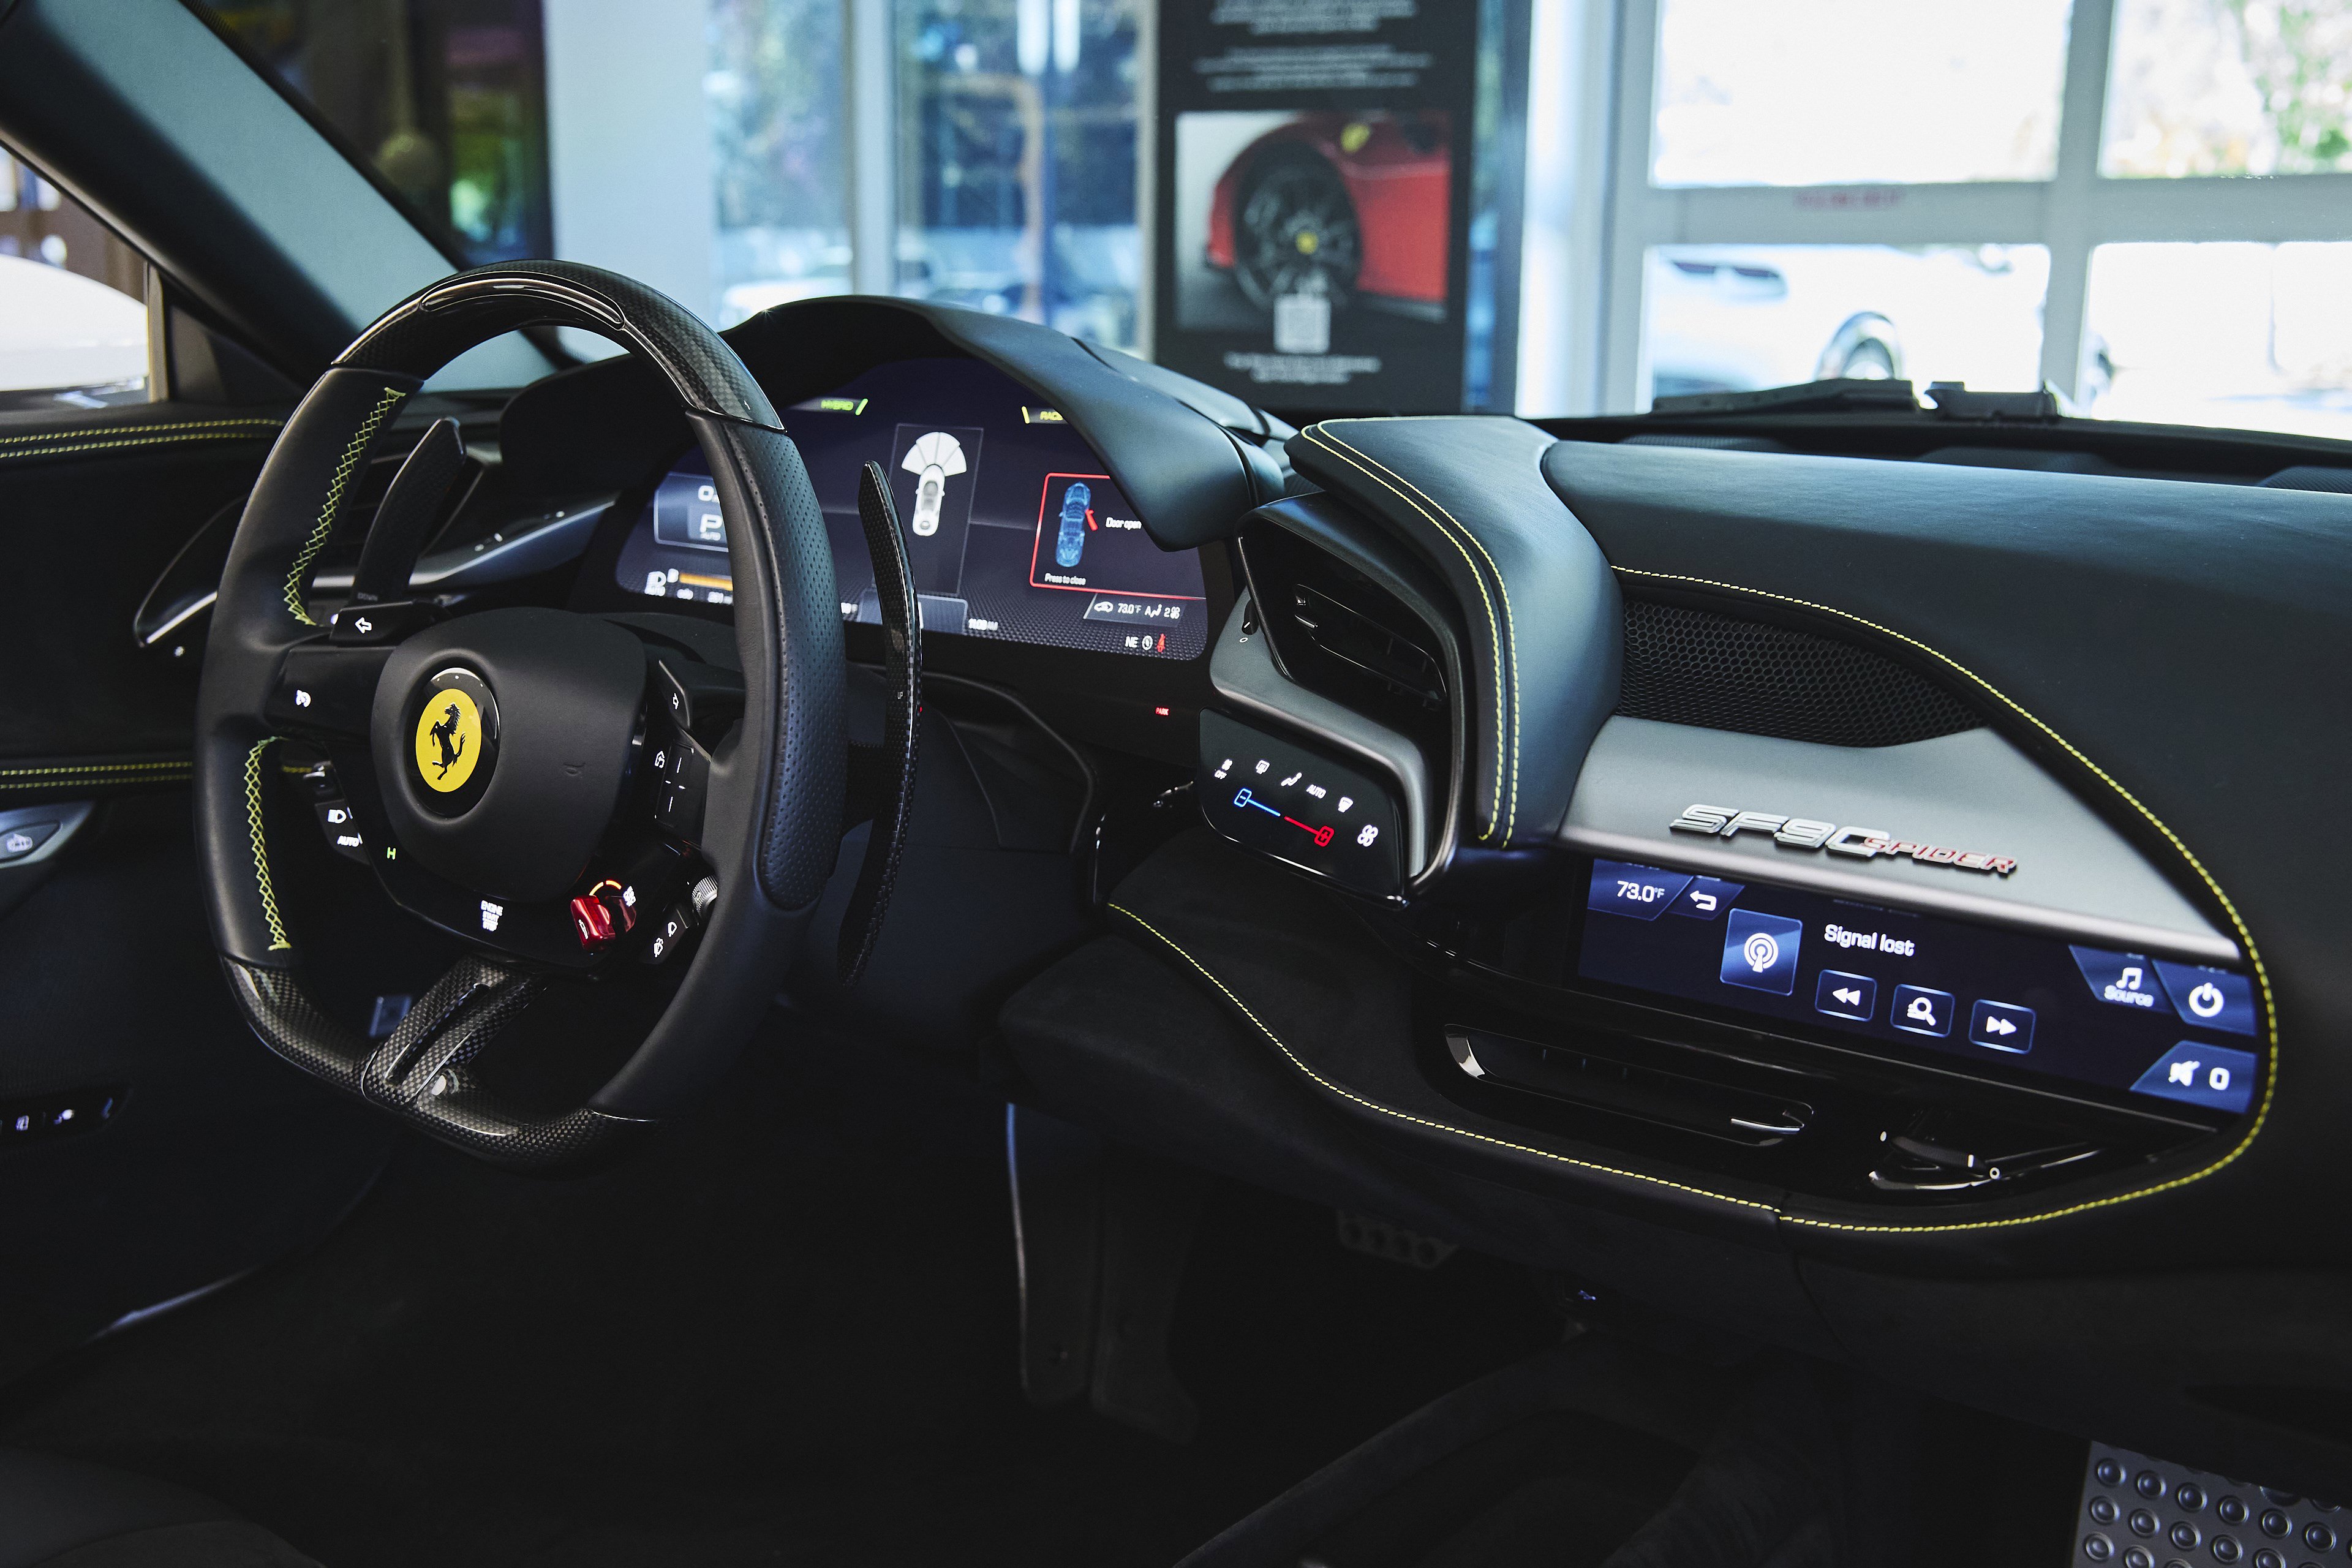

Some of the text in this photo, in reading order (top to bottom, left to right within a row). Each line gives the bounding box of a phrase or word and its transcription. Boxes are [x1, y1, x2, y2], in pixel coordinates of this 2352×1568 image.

[699, 513, 723, 533] P
[1106, 517, 1142, 530] Door open
[1044, 573, 1087, 586] Press to close
[1125, 636, 1139, 648] NE
[1155, 707, 1169, 716] PARK
[1214, 770, 1227, 780] OFF
[1306, 784, 1327, 799] AUTO
[337, 835, 360, 848] AUTO
[386, 846, 396, 860] H
[1862, 837, 2018, 874] SPIDER
[1617, 880, 1665, 903] 73.0°F
[481, 900, 503, 916] ENGINE
[483, 910, 500, 923] START
[483, 921, 497, 932] STOP
[1824, 924, 1915, 957] Signal lost
[2103, 984, 2155, 1008] Source
[2209, 1067, 2231, 1091] 0
